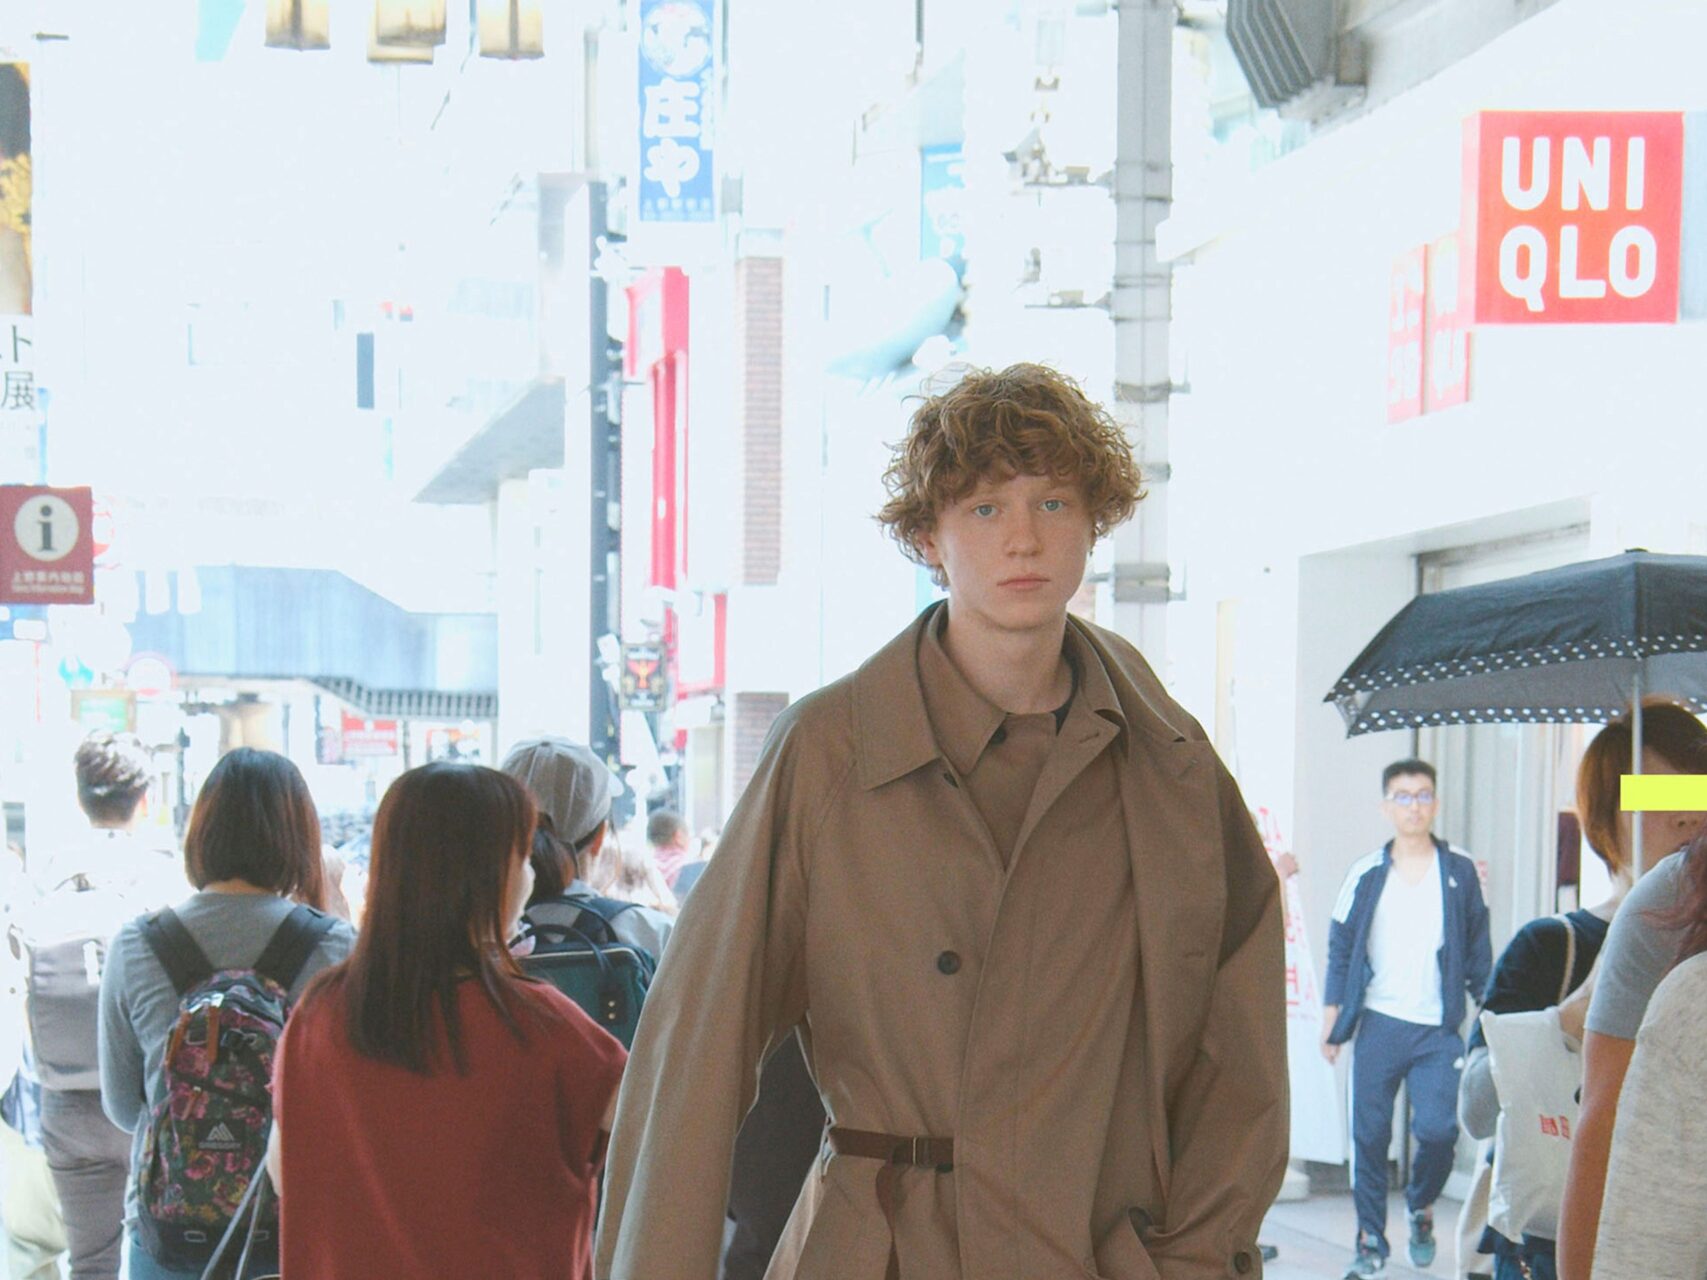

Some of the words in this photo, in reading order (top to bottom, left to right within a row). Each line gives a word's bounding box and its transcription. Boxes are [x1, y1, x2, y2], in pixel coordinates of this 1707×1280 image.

[643, 77, 701, 199] 庄や
[1501, 136, 1646, 211] UNI
[1499, 225, 1657, 312] QLO
[1, 371, 35, 410] 展
